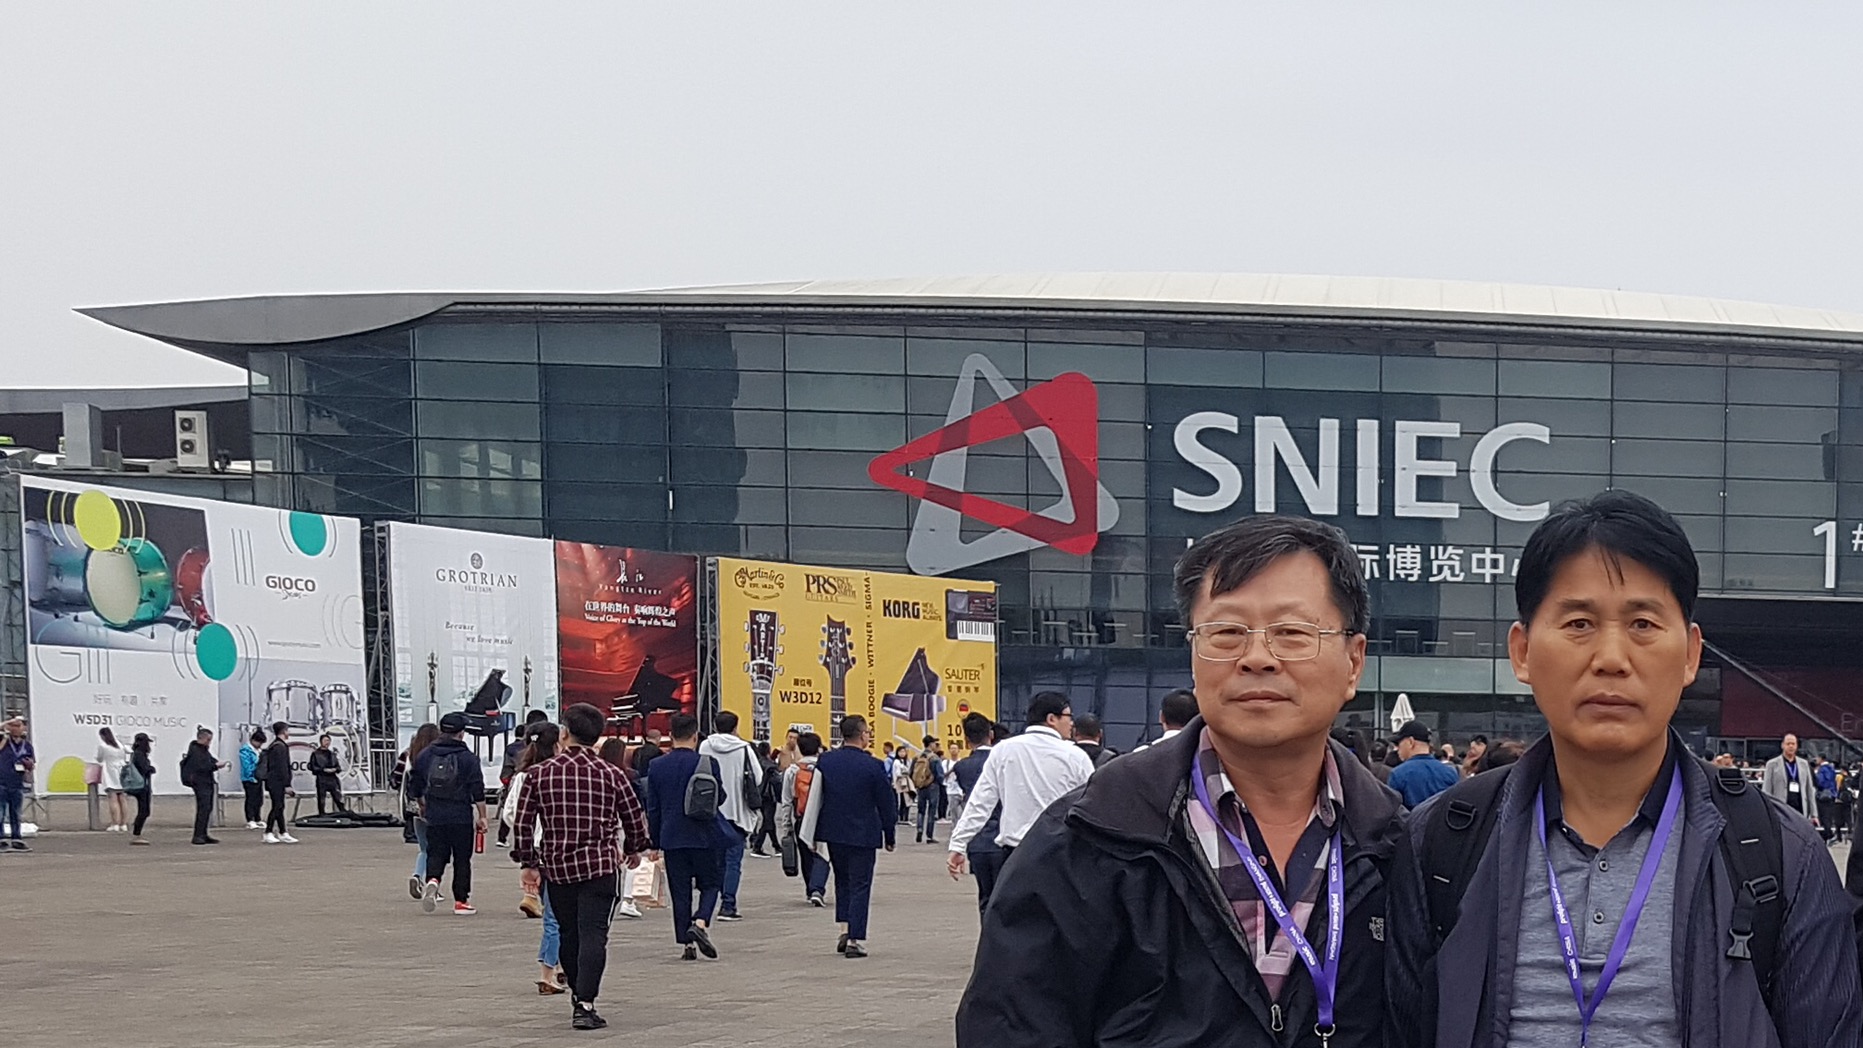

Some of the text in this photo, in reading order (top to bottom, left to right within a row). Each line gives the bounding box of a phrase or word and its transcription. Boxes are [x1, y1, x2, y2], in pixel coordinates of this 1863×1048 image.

[1172, 411, 1551, 523] SNIEC
[265, 575, 316, 592] GIOCO
[436, 568, 517, 587] GROTRIAN
[804, 573, 837, 595] PRS
[883, 599, 920, 619] KORG
[866, 621, 874, 668] WITTNER
[945, 668, 980, 680] SAUTER
[779, 690, 822, 704] W3D12
